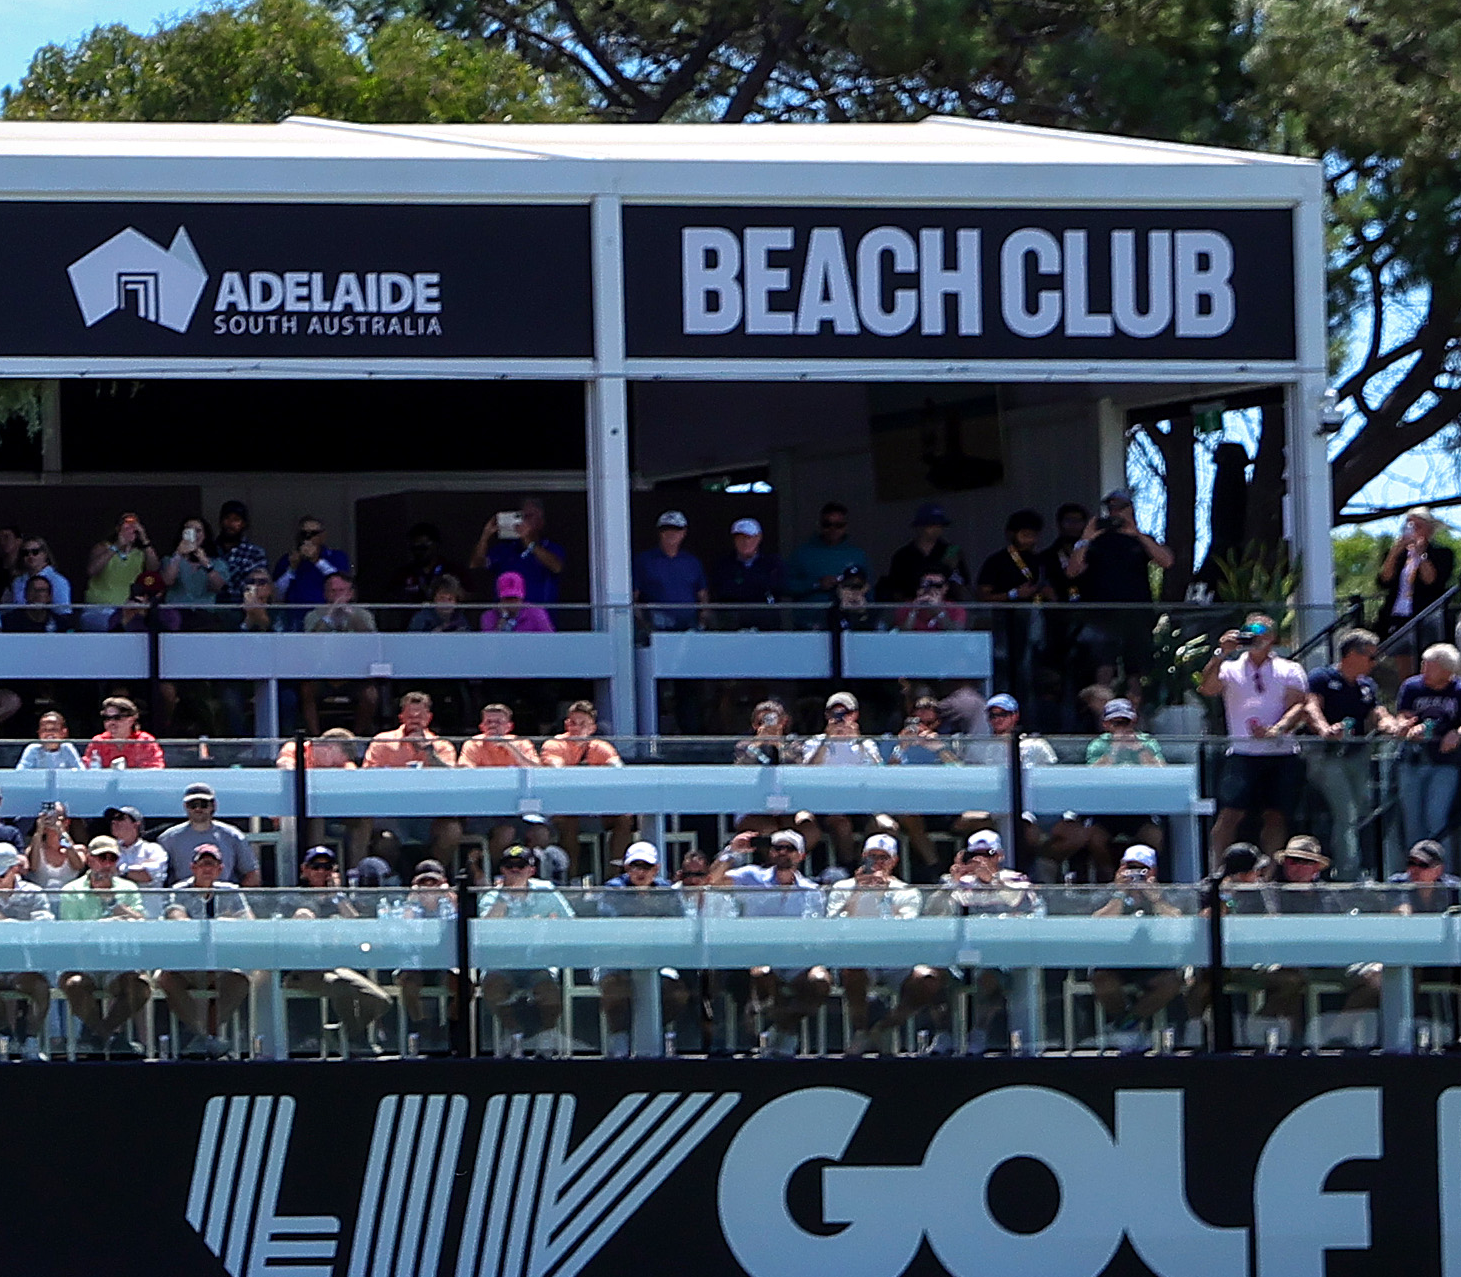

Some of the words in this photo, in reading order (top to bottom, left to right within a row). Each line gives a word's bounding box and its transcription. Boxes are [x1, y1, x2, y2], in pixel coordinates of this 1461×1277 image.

[214, 271, 442, 313] ADELAIDE
[682, 226, 982, 336] BEACH
[1001, 227, 1235, 338] CLUB
[214, 314, 297, 335] SOUTH
[307, 315, 442, 336] AUSTRALIA
